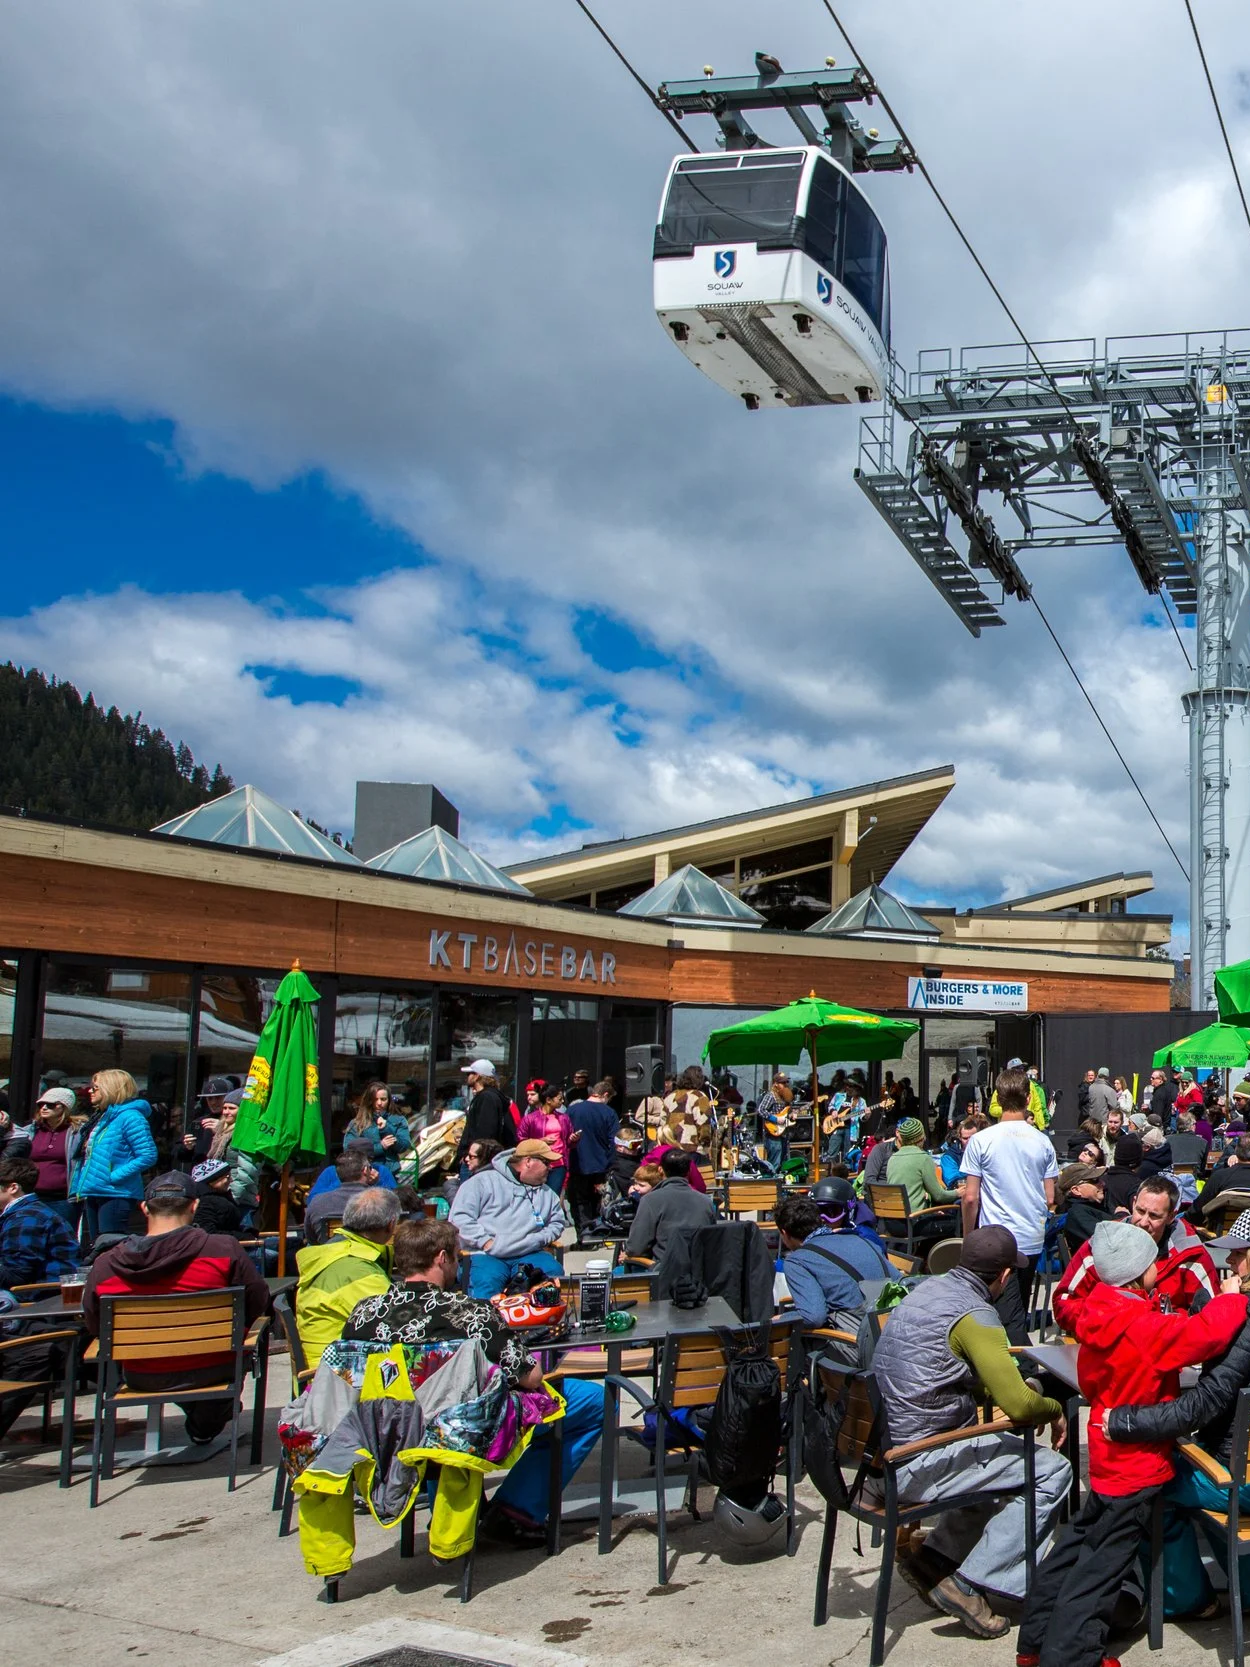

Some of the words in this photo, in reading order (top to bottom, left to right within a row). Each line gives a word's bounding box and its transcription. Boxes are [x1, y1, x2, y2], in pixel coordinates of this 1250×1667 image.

[707, 282, 744, 291] SQUAW
[836, 296, 867, 332] SQUAW
[926, 982, 978, 994] BURGERS
[982, 985, 989, 994] &
[992, 985, 1023, 996] MORE
[926, 994, 964, 1005] INSIDE
